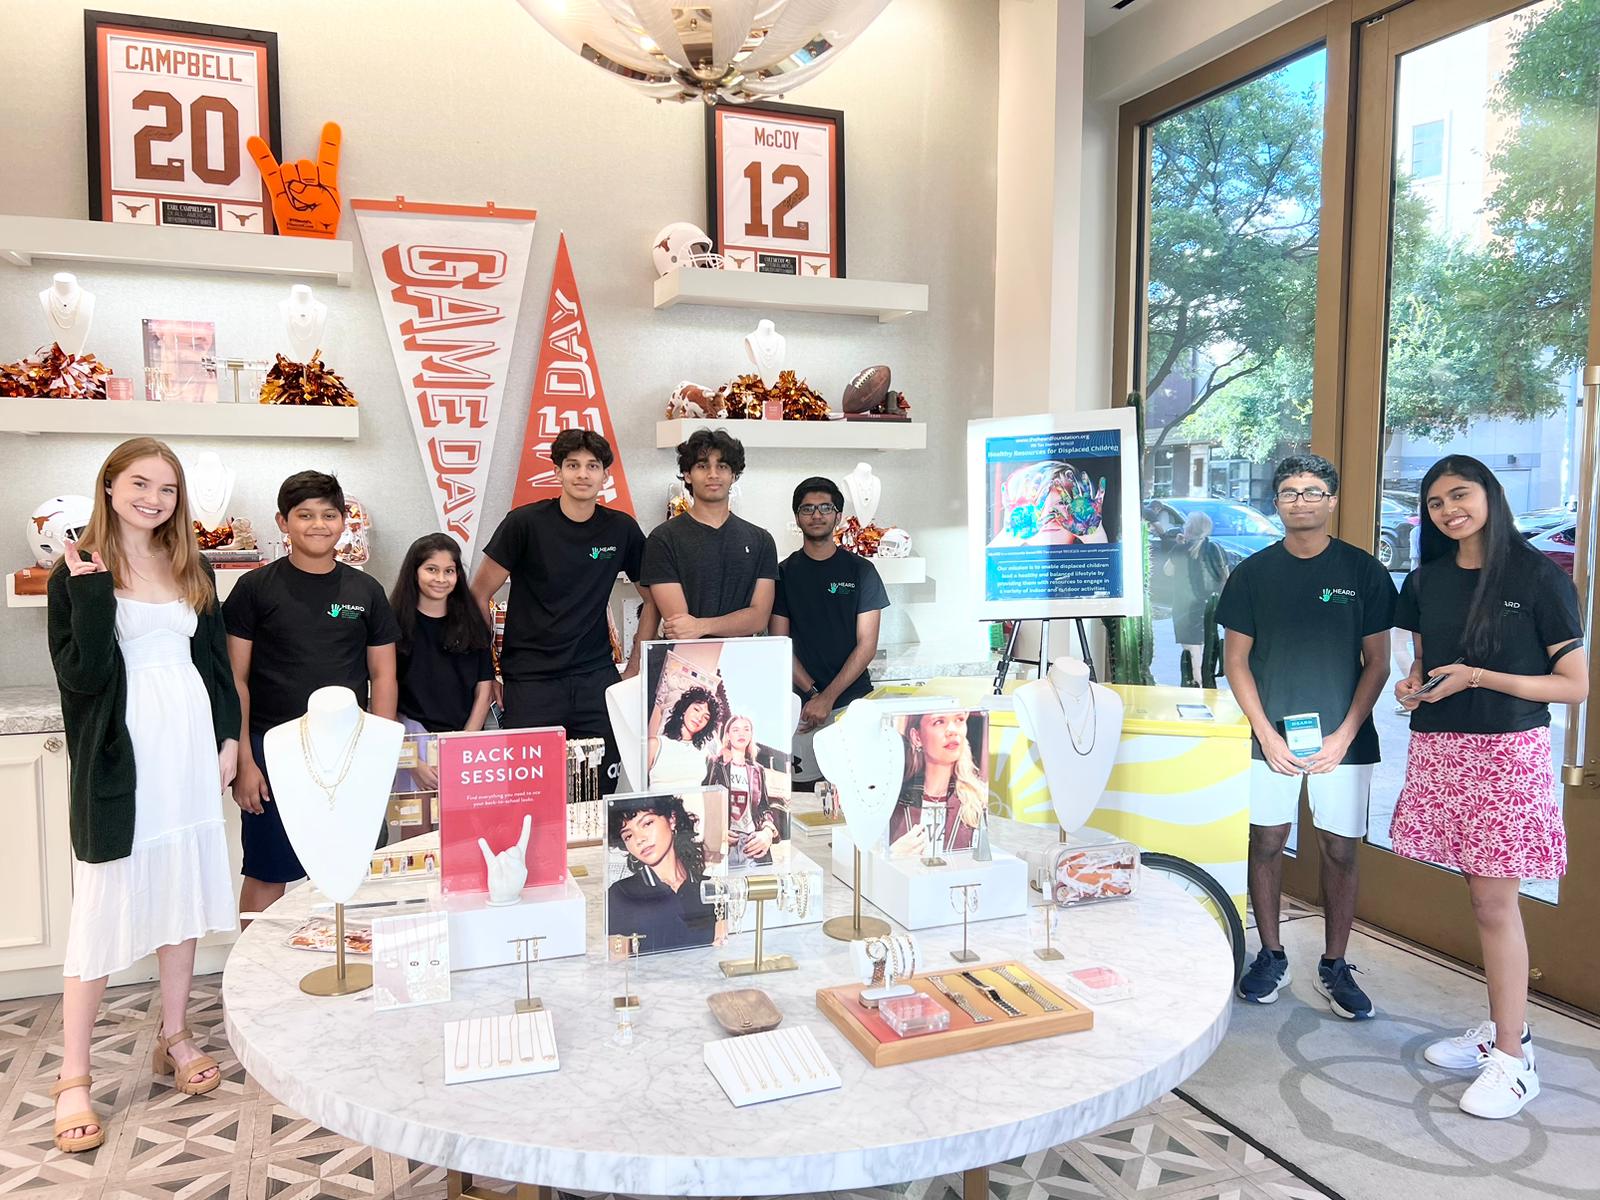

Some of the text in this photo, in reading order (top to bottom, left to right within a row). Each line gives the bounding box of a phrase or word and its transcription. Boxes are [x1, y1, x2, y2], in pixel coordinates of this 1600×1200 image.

[125, 45, 243, 82] CAMPBELL
[132, 89, 241, 186] 20
[754, 126, 799, 150] McCOY
[743, 161, 810, 241] 12
[543, 288, 597, 400] DAY
[381, 243, 507, 543] GAME DAY
[1047, 447, 1058, 455] for
[1058, 446, 1090, 454] Displaced
[1091, 444, 1119, 452] Children
[1332, 588, 1356, 597] HEARD
[341, 604, 365, 612] HEARD
[462, 745, 542, 764] BACK IN
[460, 765, 544, 785] SESSION
